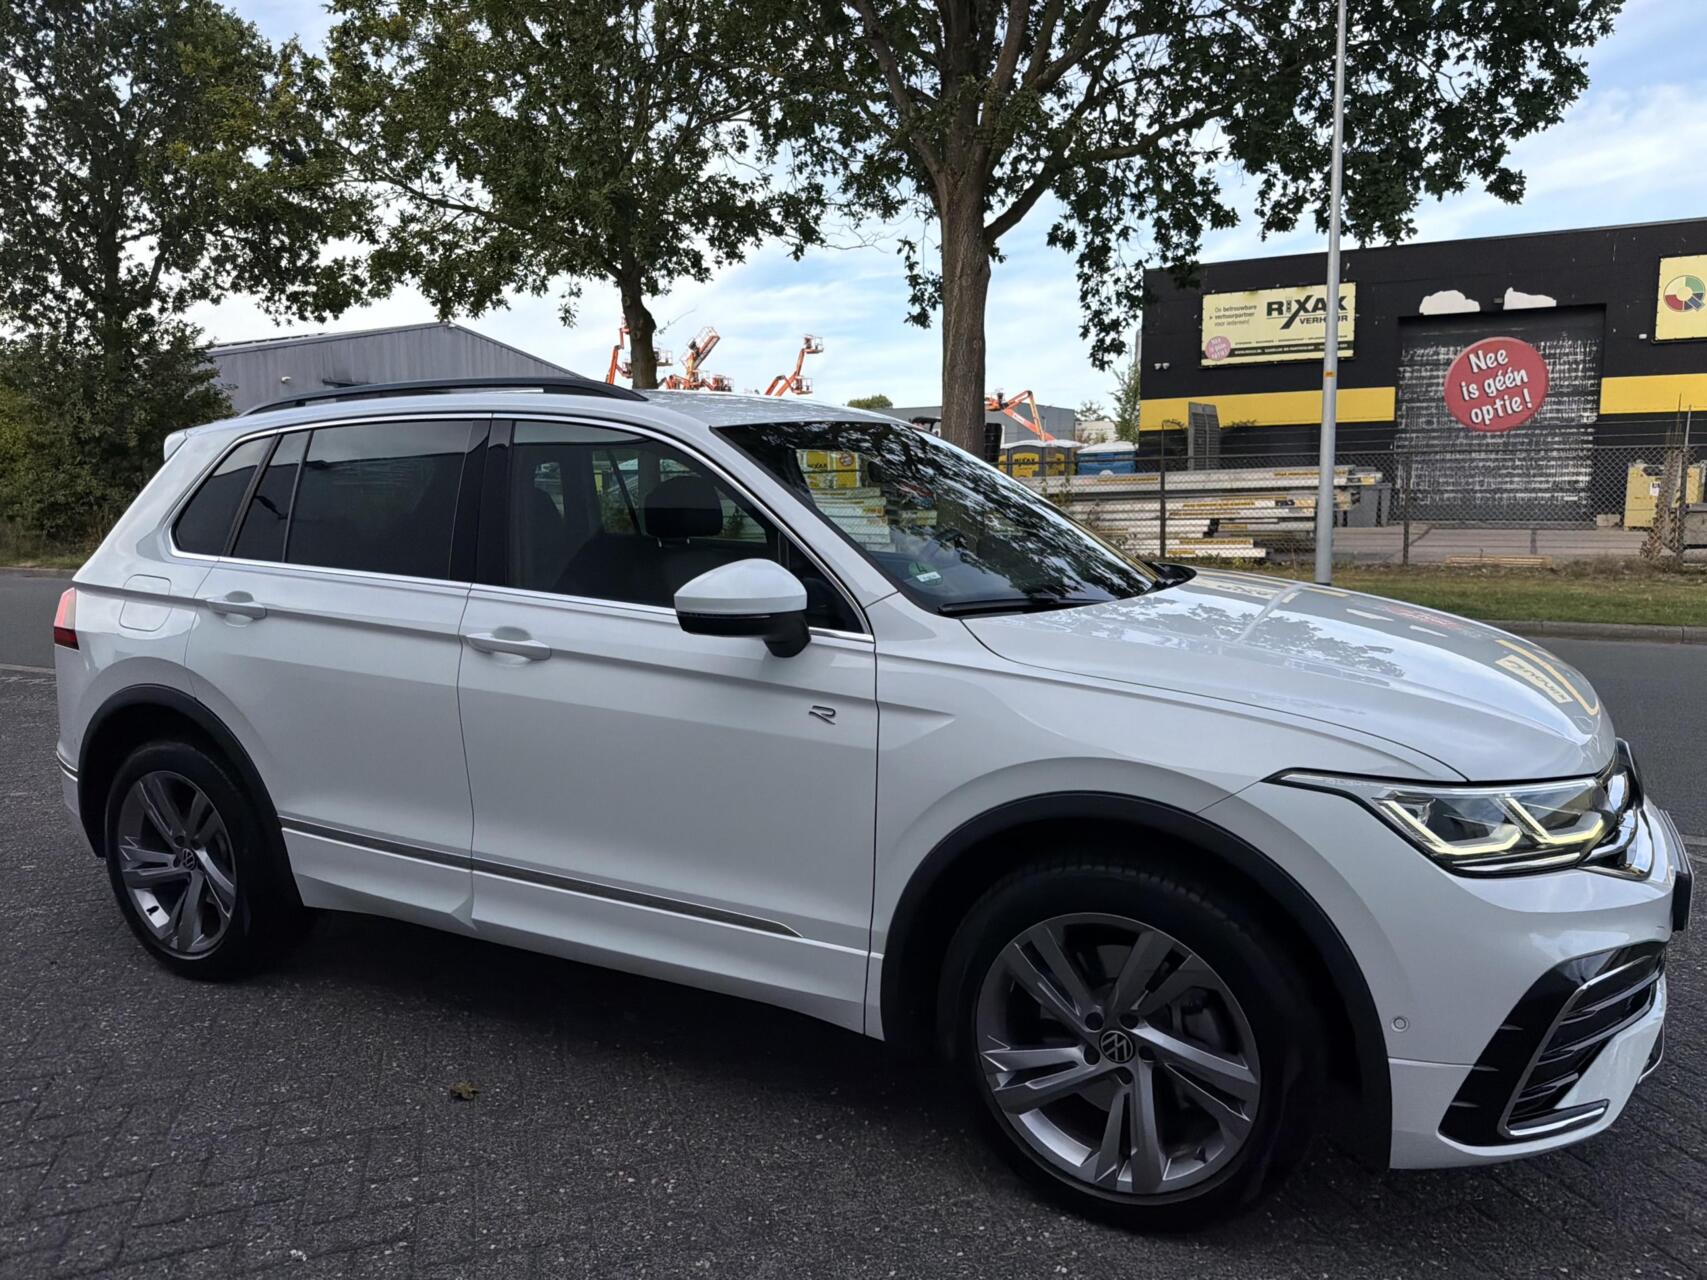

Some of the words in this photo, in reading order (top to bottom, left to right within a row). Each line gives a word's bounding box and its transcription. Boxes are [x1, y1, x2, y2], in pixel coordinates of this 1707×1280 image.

[1468, 349, 1509, 373] Nee
[1460, 381, 1479, 401] is
[1484, 367, 1528, 397] géén
[808, 705, 837, 726] R
